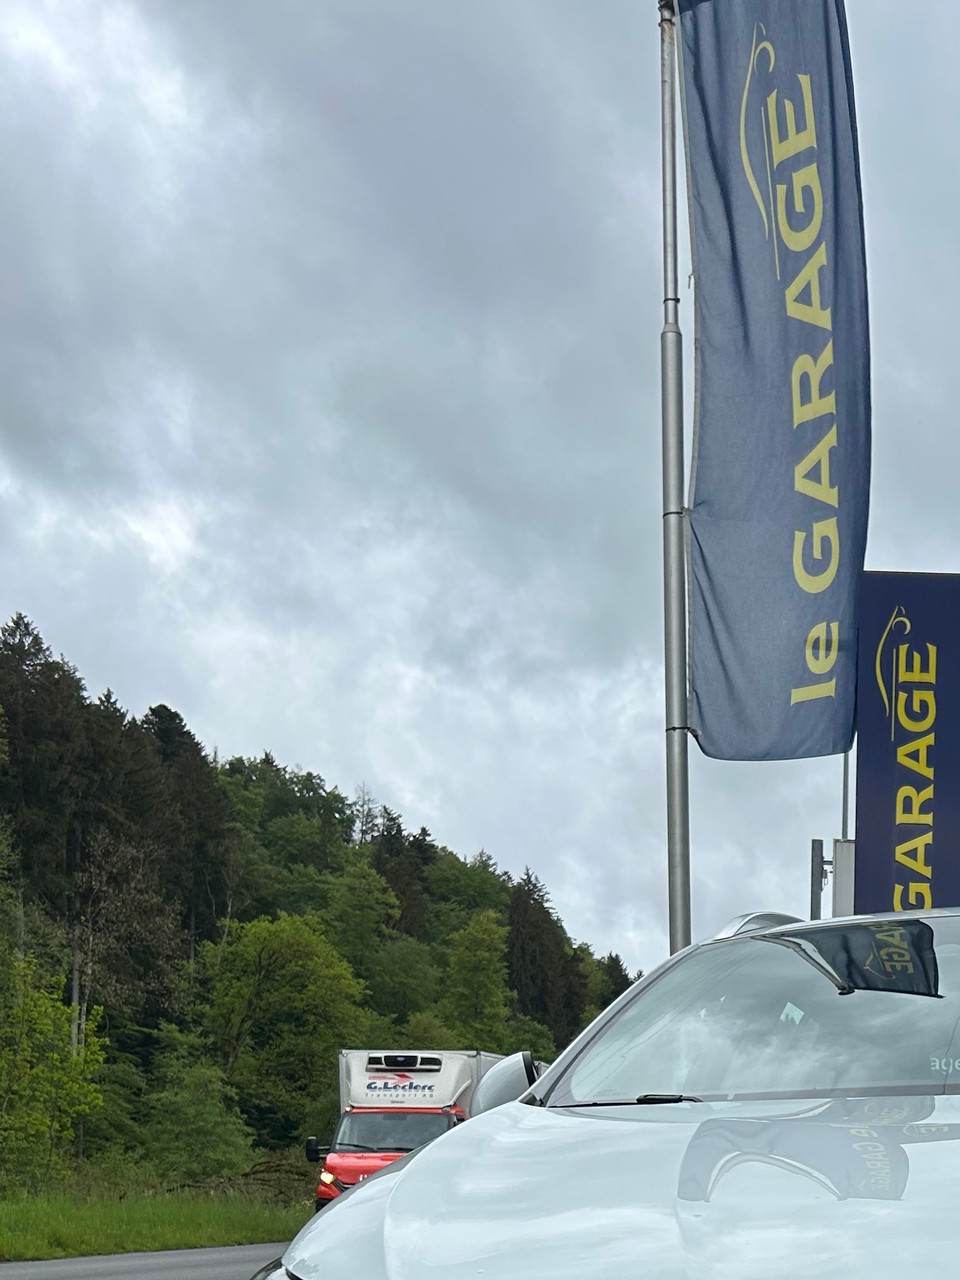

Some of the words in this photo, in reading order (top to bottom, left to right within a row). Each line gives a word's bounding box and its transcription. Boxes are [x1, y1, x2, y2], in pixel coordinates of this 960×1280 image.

[767, 73, 840, 594] GARAGE
[790, 620, 839, 707] le
[893, 641, 938, 912] GARAGE
